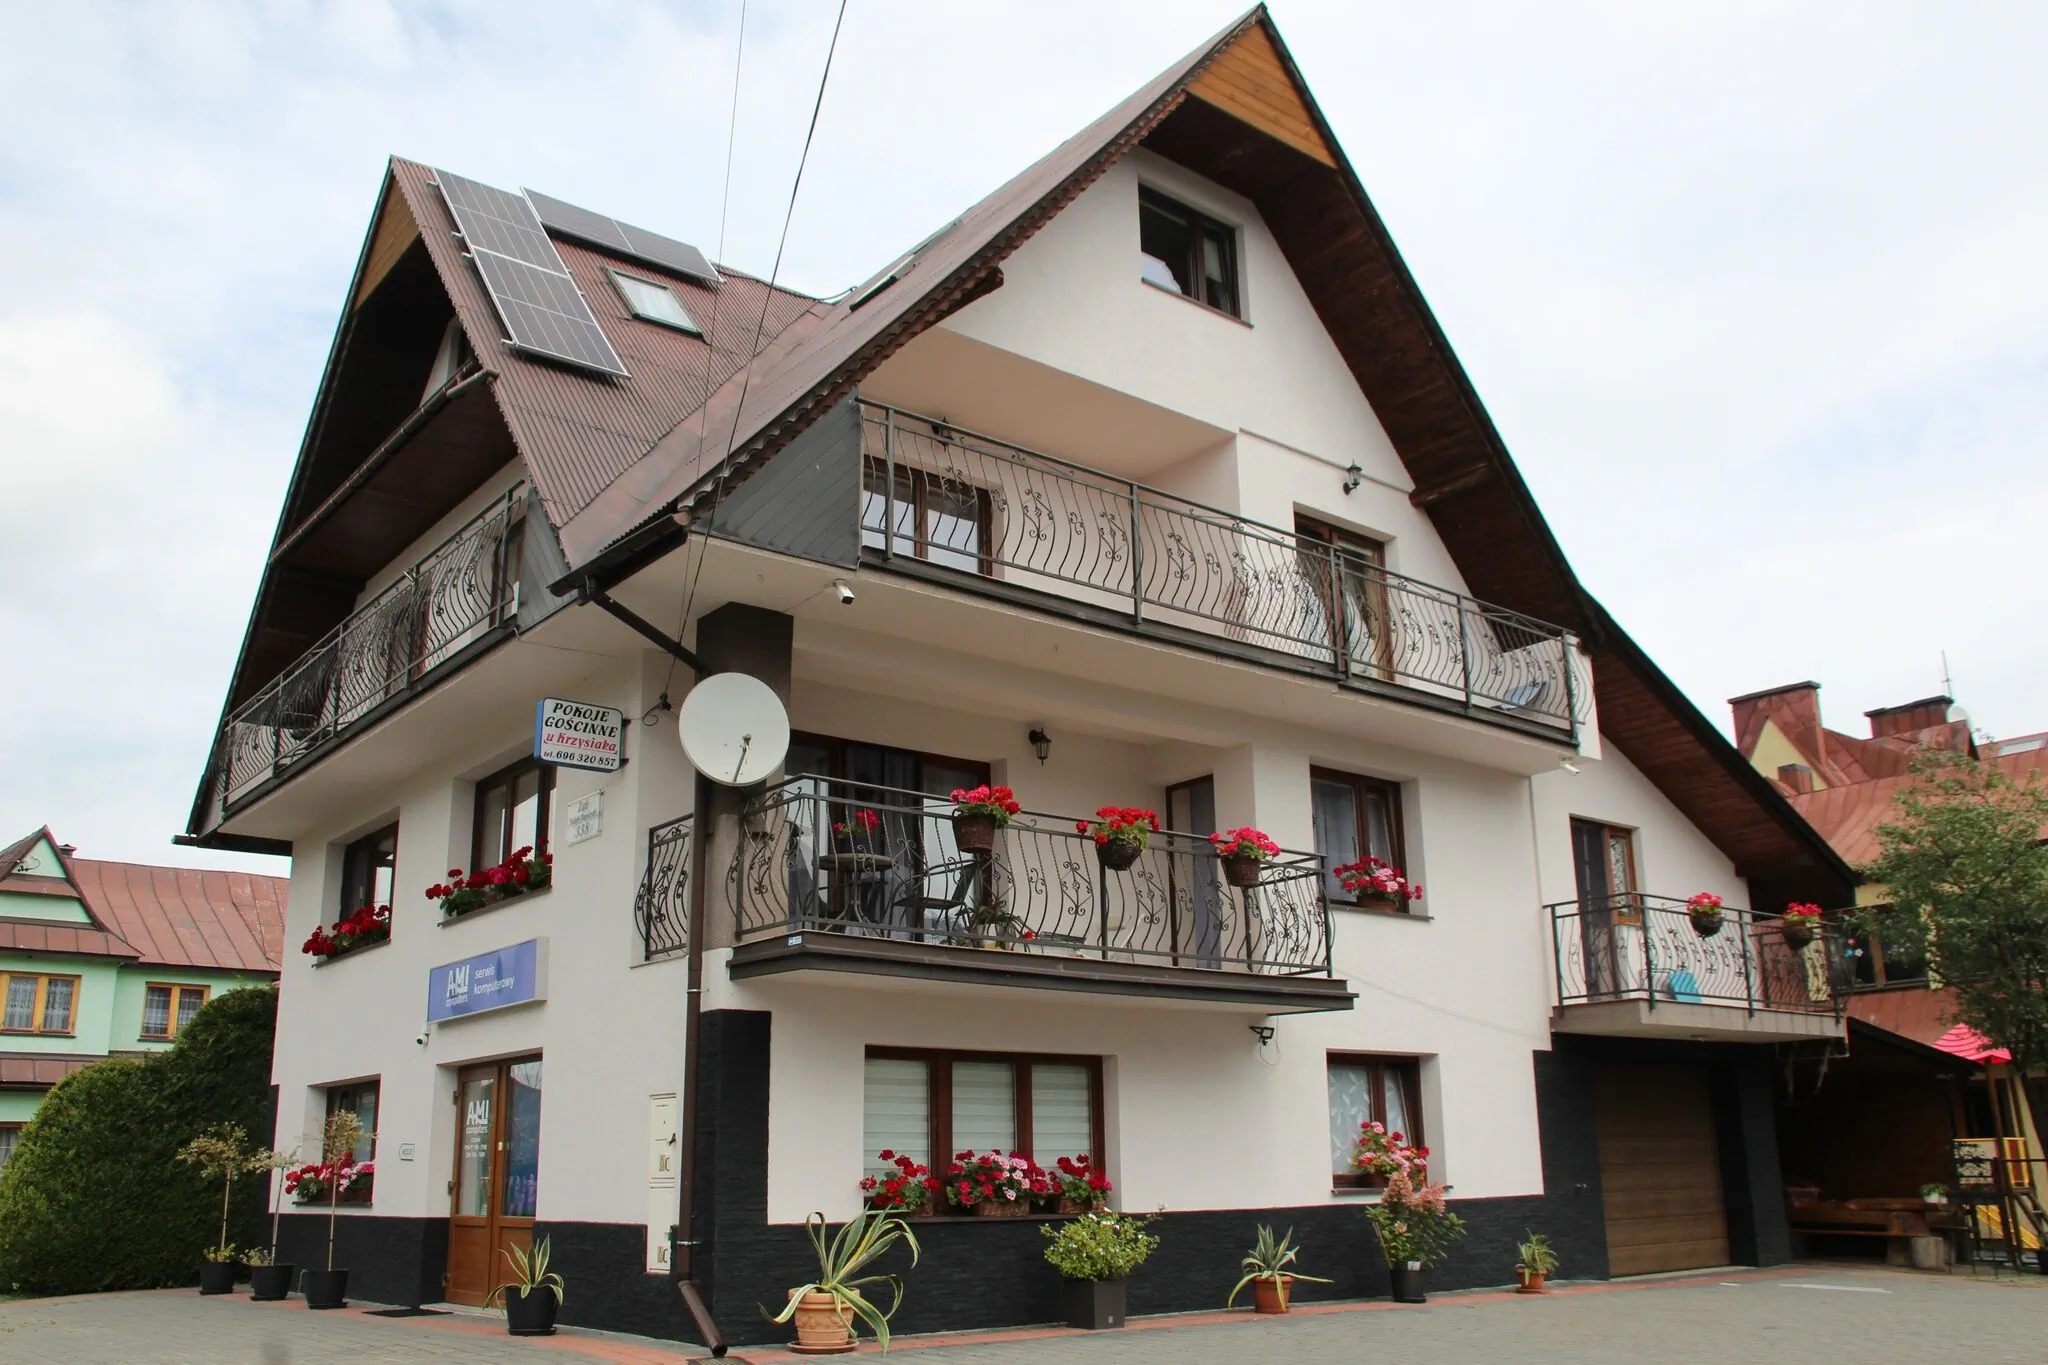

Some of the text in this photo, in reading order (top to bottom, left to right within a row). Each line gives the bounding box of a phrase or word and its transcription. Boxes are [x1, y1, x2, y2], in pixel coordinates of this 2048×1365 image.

[552, 702, 610, 722] POKOJE
[544, 716, 618, 738] GOŚCINNE
[546, 733, 617, 752] u Krzysiaka
[556, 751, 576, 761] 696
[577, 754, 597, 764] 320
[597, 758, 617, 767] 857
[446, 964, 470, 999] AMI
[474, 964, 496, 979] serwis
[473, 976, 515, 996] komputerowy
[466, 1099, 490, 1126] AMI
